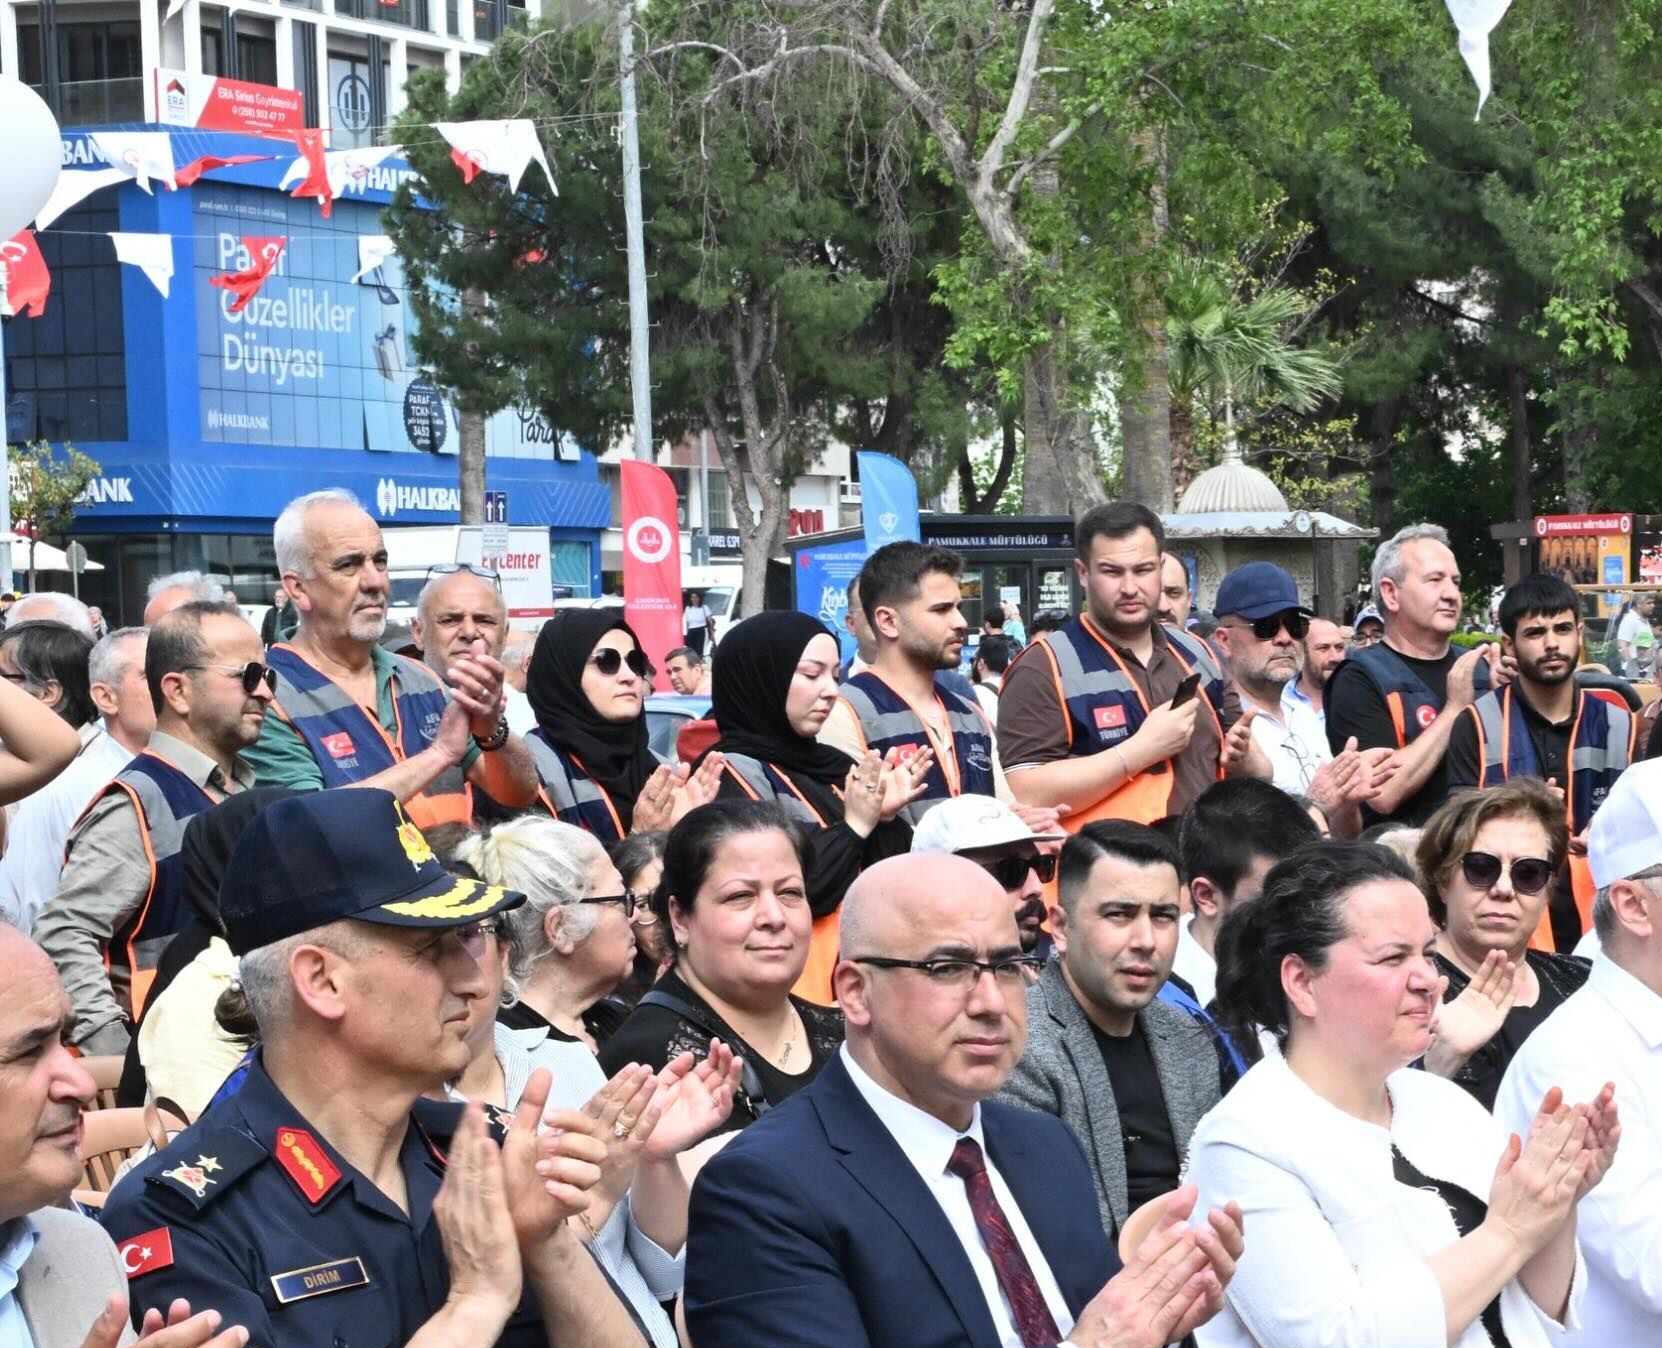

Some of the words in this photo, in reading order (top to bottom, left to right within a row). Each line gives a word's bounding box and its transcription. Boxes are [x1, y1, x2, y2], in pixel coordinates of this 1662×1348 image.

[167, 95, 185, 106] ERA
[223, 331, 324, 385] Dünyası
[218, 413, 270, 431] HALKBANK
[928, 536, 988, 546] PAMUKKALE
[988, 534, 1049, 545] MÜFTÜLÜĞÜ
[303, 1269, 341, 1289] DİRİM
